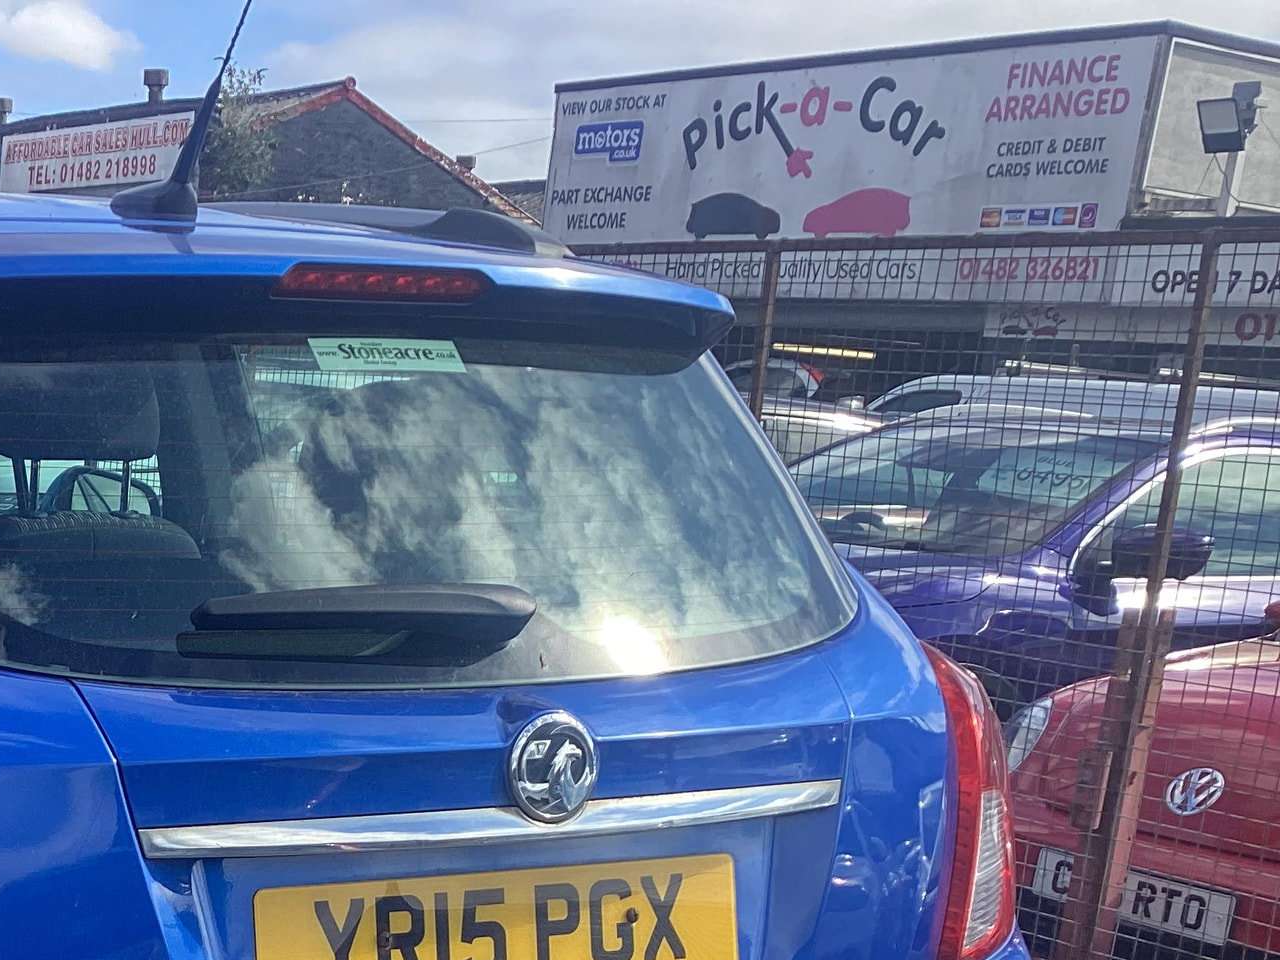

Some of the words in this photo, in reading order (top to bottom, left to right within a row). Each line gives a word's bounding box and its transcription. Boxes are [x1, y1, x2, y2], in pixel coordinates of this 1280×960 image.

[1007, 54, 1121, 90] FINANCE
[562, 101, 587, 115] VIEW
[589, 98, 611, 113] OUR
[615, 95, 651, 111] STOCK
[653, 94, 667, 109] AT
[985, 87, 1130, 123] ARRANGED
[4, 134, 70, 164] AFFORDABLE
[71, 130, 93, 157] CAR
[94, 126, 129, 154] SALES
[577, 123, 641, 150] motors
[997, 139, 1044, 157] CREDIT
[1047, 138, 1057, 154] &
[1062, 137, 1107, 153] DEBIT
[28, 165, 56, 186] TEL:
[60, 160, 100, 184] 01482
[105, 153, 157, 179] 218998
[986, 162, 1031, 178] CARDS
[1035, 158, 1109, 176] WELCOME
[551, 188, 581, 205] PART
[583, 185, 652, 203] EXCHANGE
[567, 212, 627, 230] WELCOME
[666, 258, 705, 280] Hand
[710, 257, 761, 279] Picked
[777, 258, 821, 284] uality
[824, 258, 870, 280] Used
[875, 257, 917, 280] Cars
[959, 256, 1020, 281] 01482
[1026, 256, 1100, 281] 326821
[1131, 880, 1206, 930] RTO
